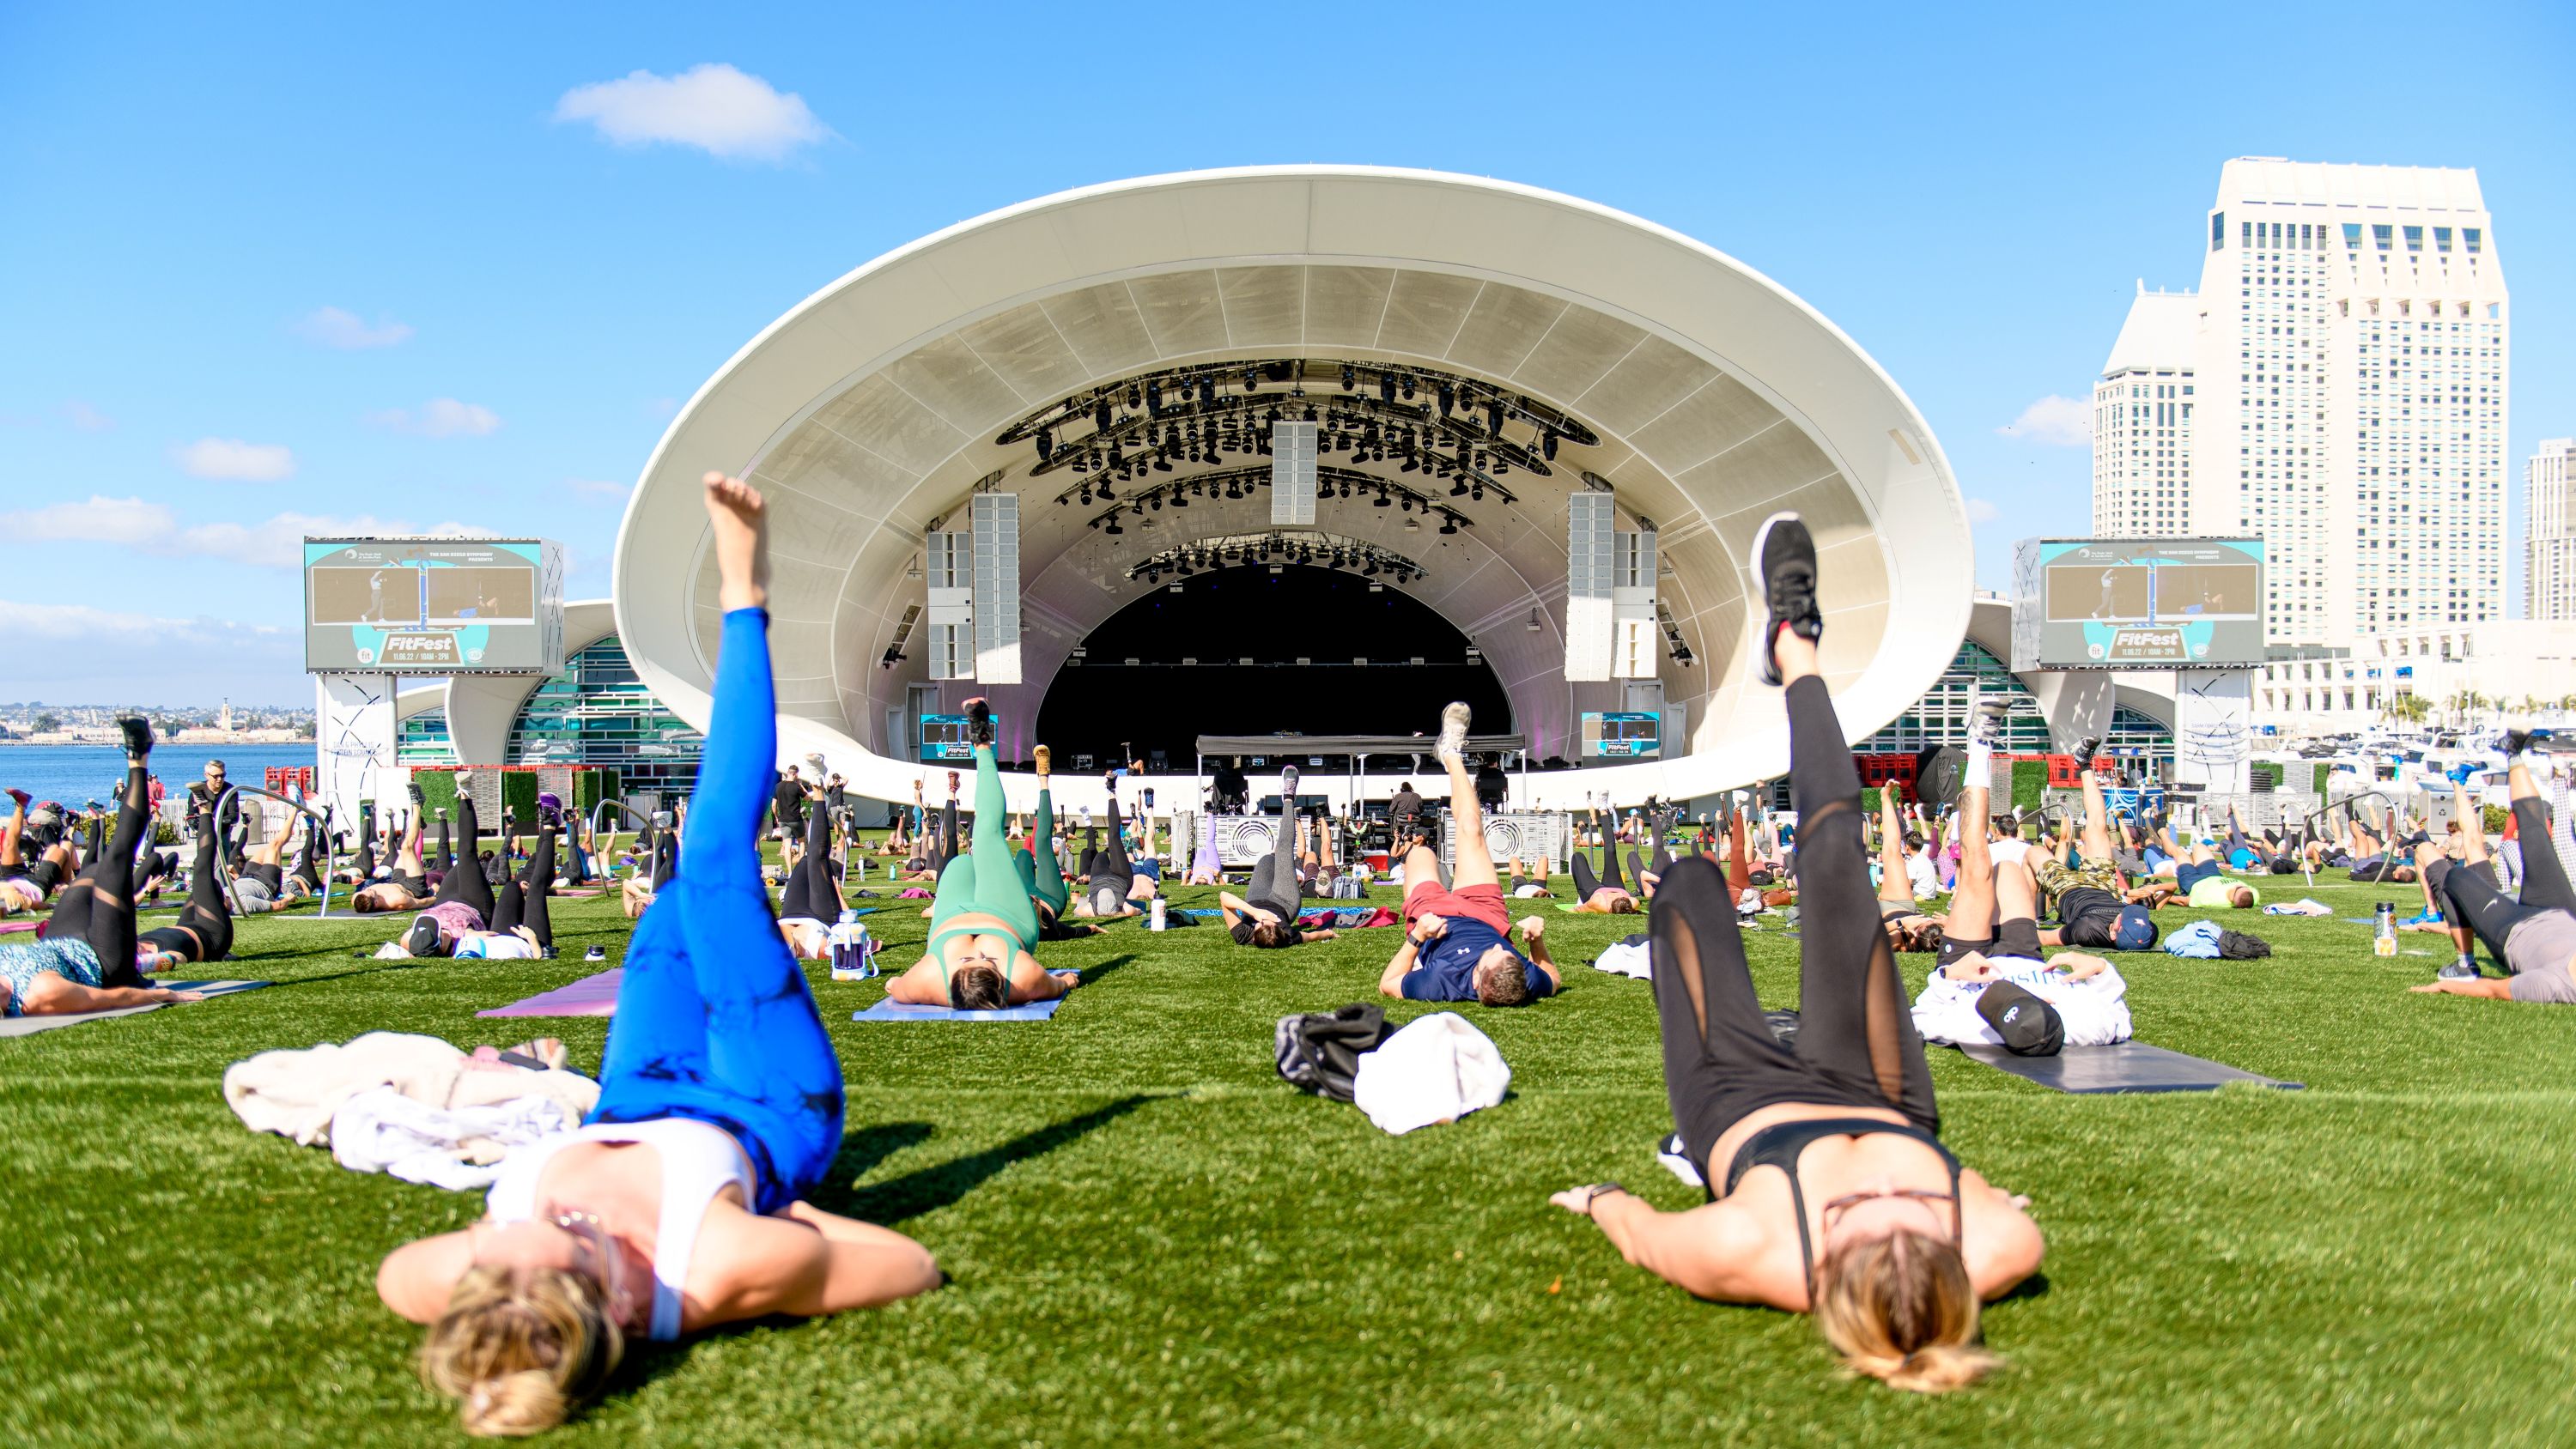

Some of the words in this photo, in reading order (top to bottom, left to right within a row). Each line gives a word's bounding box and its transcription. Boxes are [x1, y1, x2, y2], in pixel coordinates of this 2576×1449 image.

[387, 637, 453, 651] FitFest
[2116, 633, 2179, 646] FitFest
[361, 651, 370, 660] fit
[2092, 646, 2100, 655] fit
